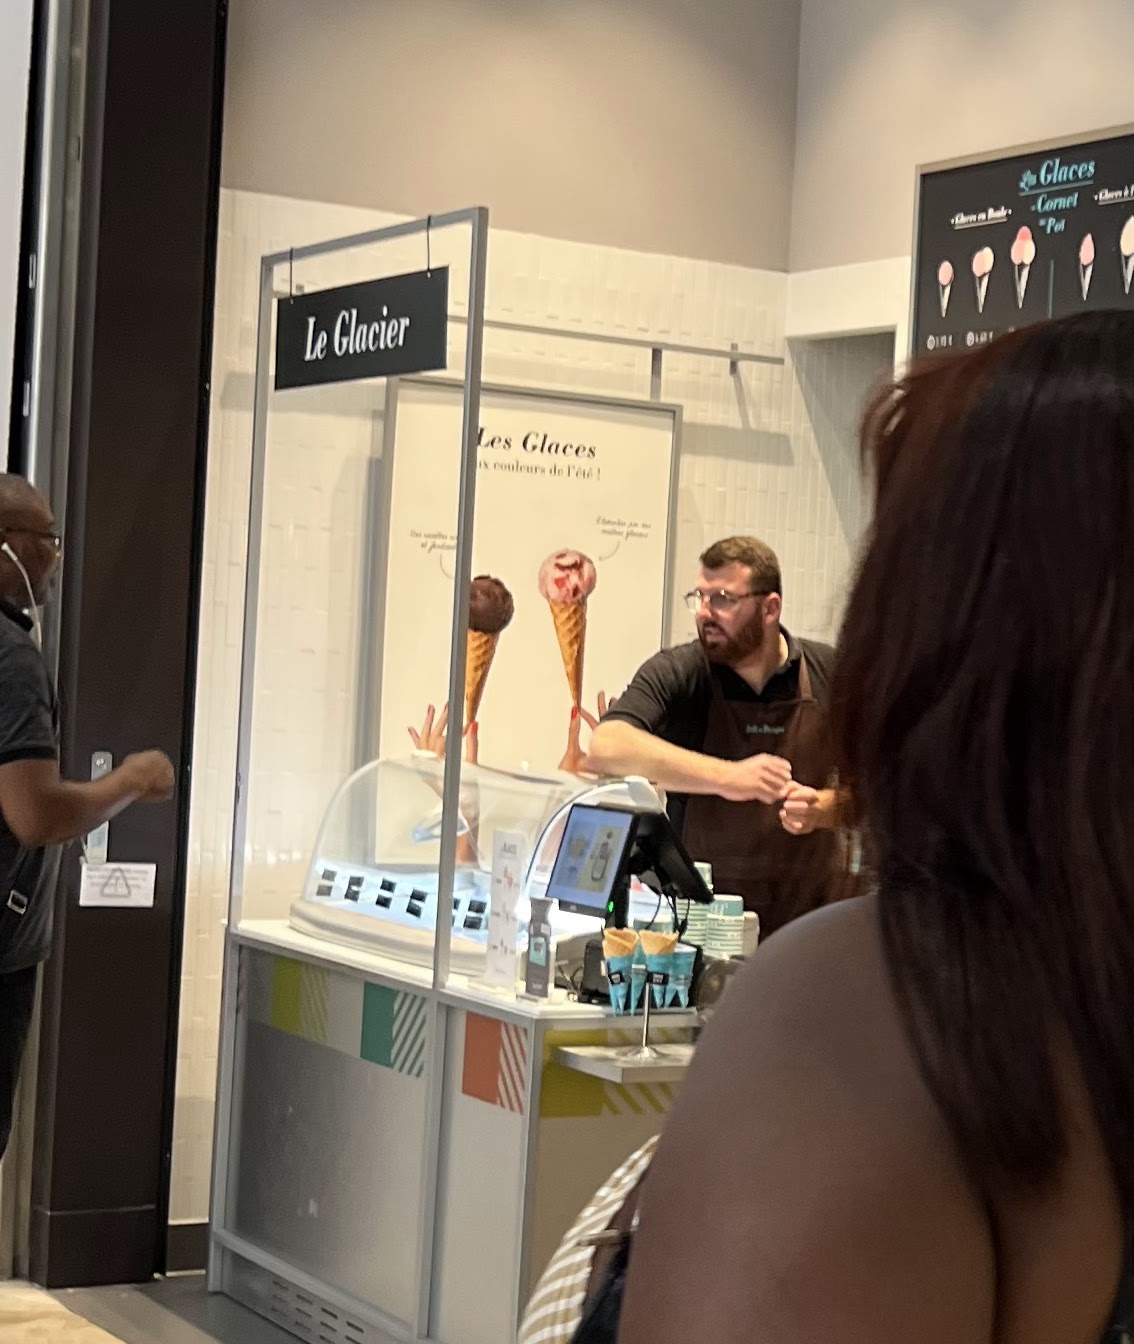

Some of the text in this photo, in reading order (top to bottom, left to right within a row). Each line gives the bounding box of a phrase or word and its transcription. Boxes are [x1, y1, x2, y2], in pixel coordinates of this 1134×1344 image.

[1039, 157, 1096, 186] Glaces
[1037, 192, 1079, 214] Cornet
[1045, 218, 1066, 235] Pot
[304, 305, 410, 362] Le Glacier
[477, 427, 597, 459] Les Glaces
[493, 460, 545, 475] couleurs
[549, 464, 564, 477] de
